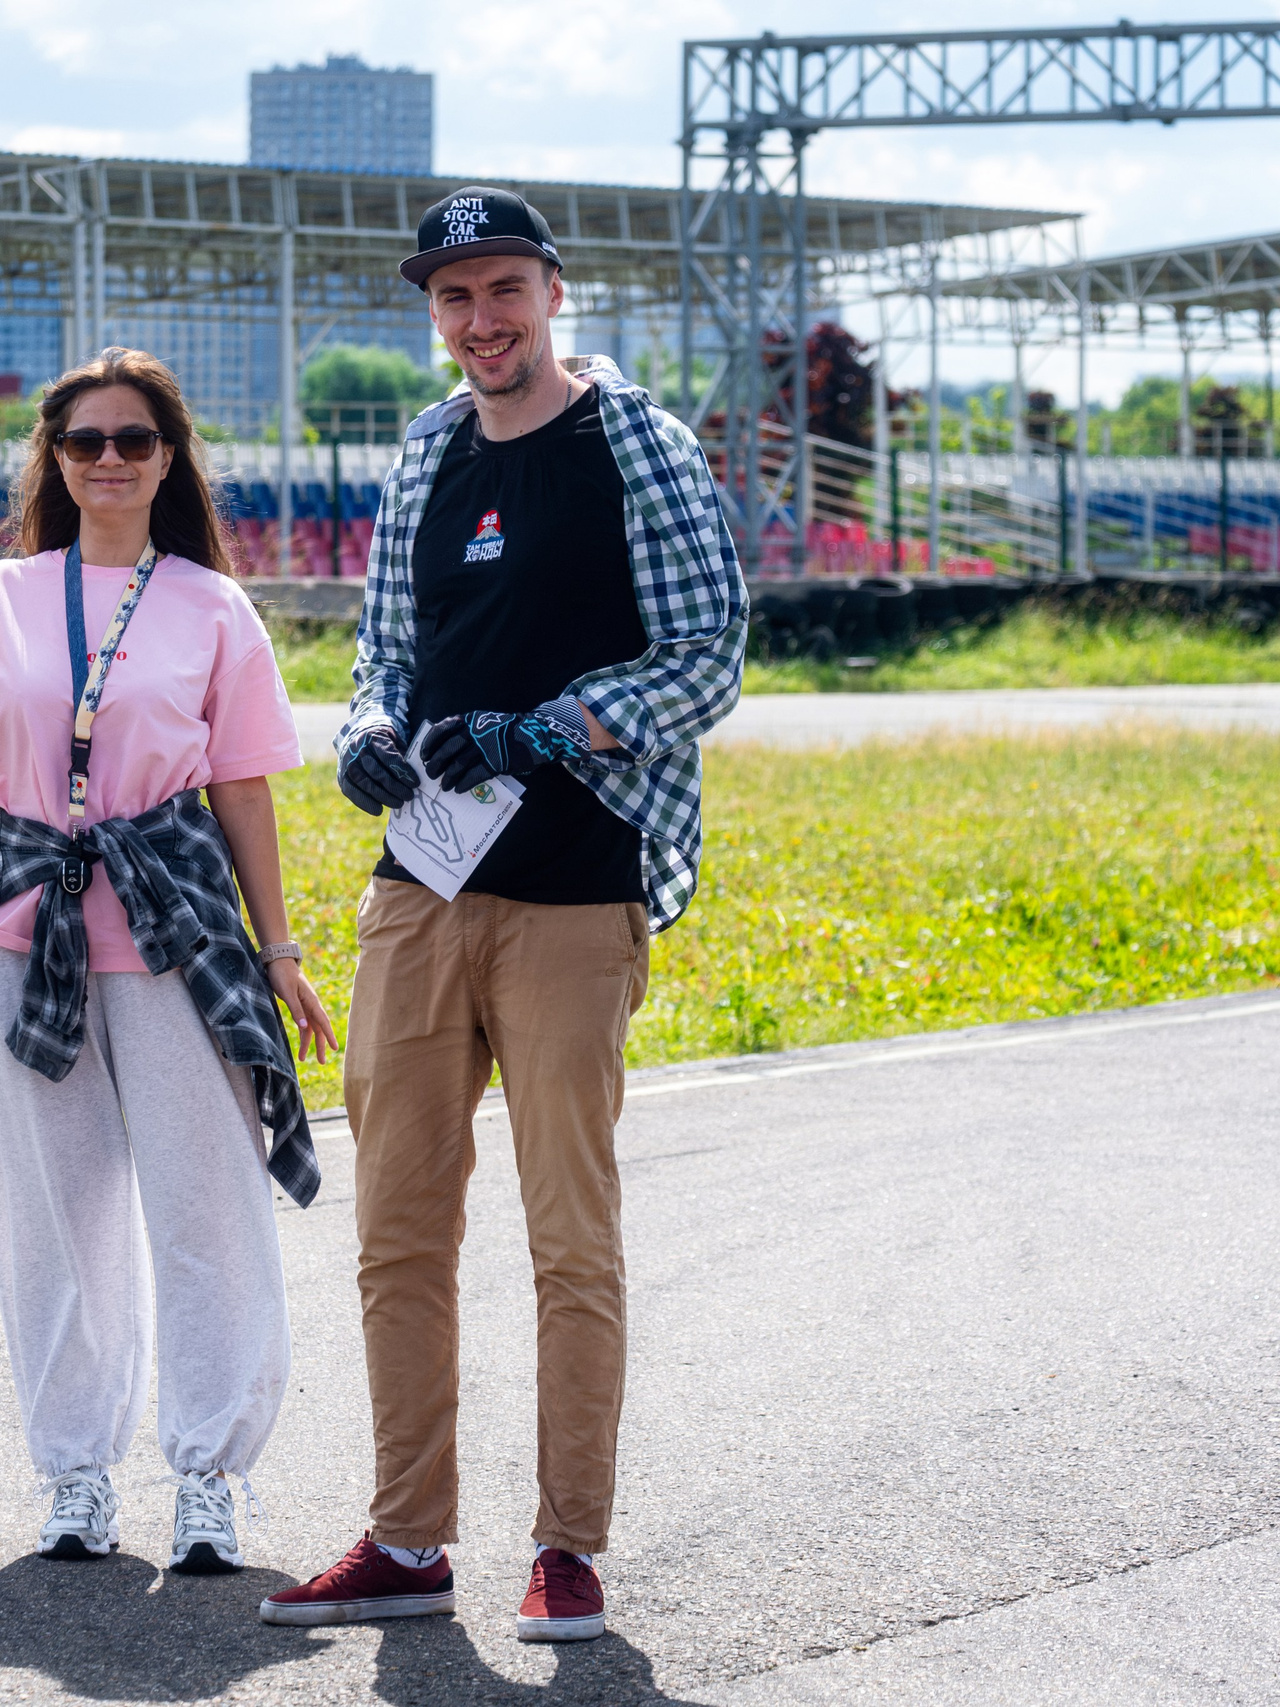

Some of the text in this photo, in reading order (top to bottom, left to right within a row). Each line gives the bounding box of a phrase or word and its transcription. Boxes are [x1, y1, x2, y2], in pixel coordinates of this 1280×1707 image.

[450, 198, 483, 211] ANTI
[442, 209, 489, 224] STOCK
[448, 222, 476, 236] CAR
[466, 544, 481, 552] ТАМ
